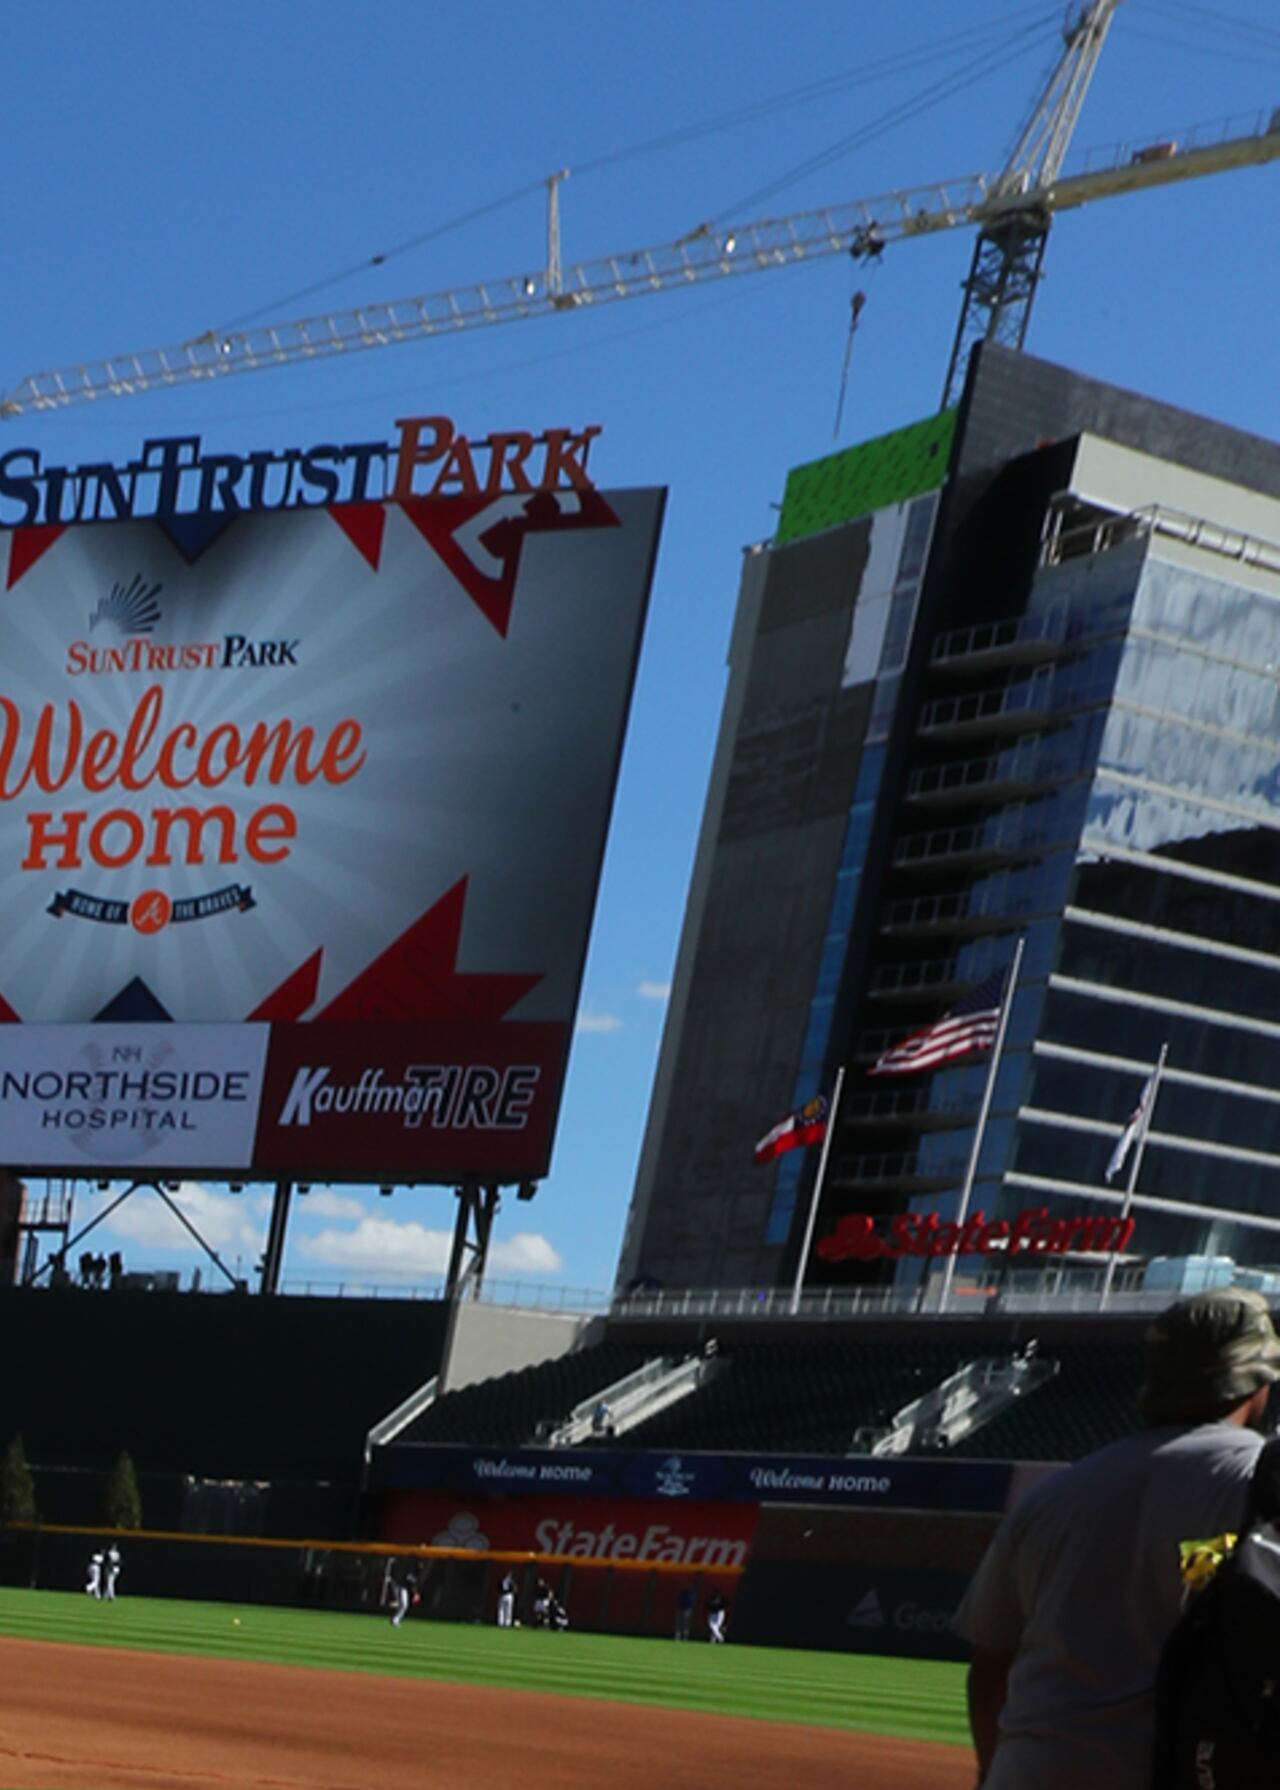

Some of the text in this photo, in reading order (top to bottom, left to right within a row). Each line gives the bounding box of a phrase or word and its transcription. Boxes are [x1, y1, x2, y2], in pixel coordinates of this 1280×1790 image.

[386, 415, 602, 499] PARK
[221, 635, 300, 668] PARK
[1, 1070, 250, 1101] NORTHSIDE
[278, 1065, 540, 1128] Kauffman TIRE
[41, 1109, 197, 1130] HOSPITAL
[473, 1458, 536, 1480] Welcome
[750, 1467, 827, 1491] Welcome
